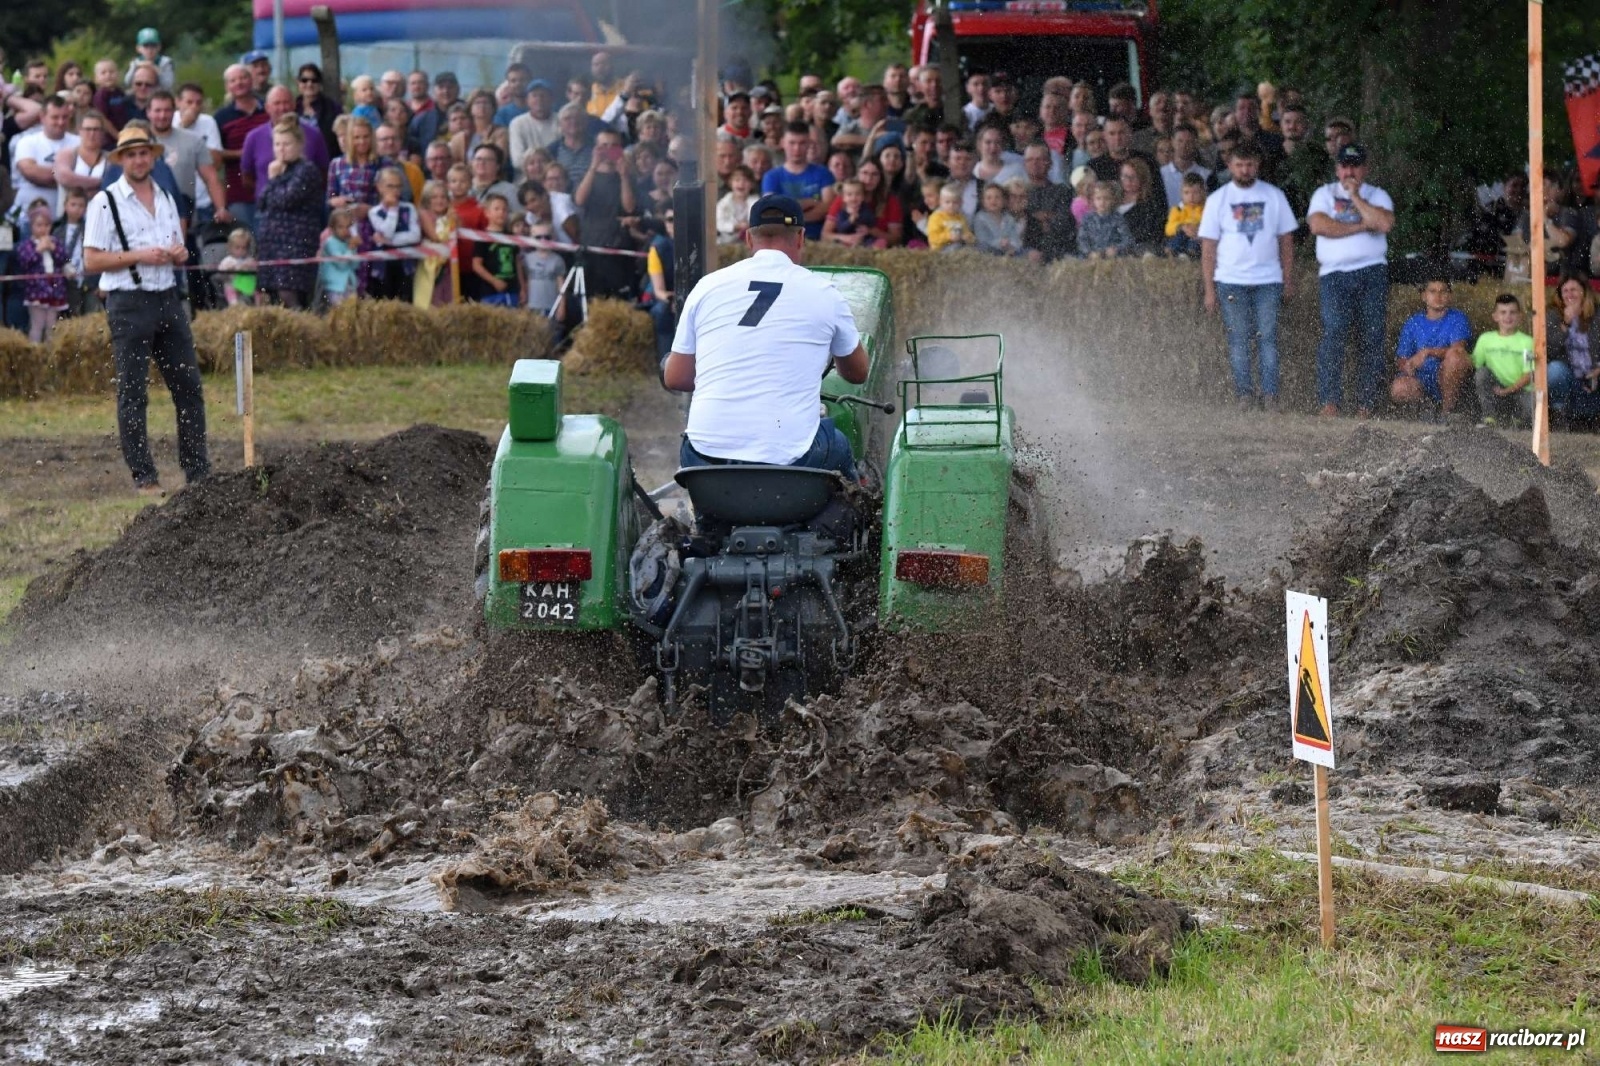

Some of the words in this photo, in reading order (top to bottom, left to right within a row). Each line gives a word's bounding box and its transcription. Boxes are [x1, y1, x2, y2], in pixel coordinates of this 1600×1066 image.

[738, 281, 783, 327] 7
[526, 583, 569, 599] KAH
[523, 602, 574, 619] 2042
